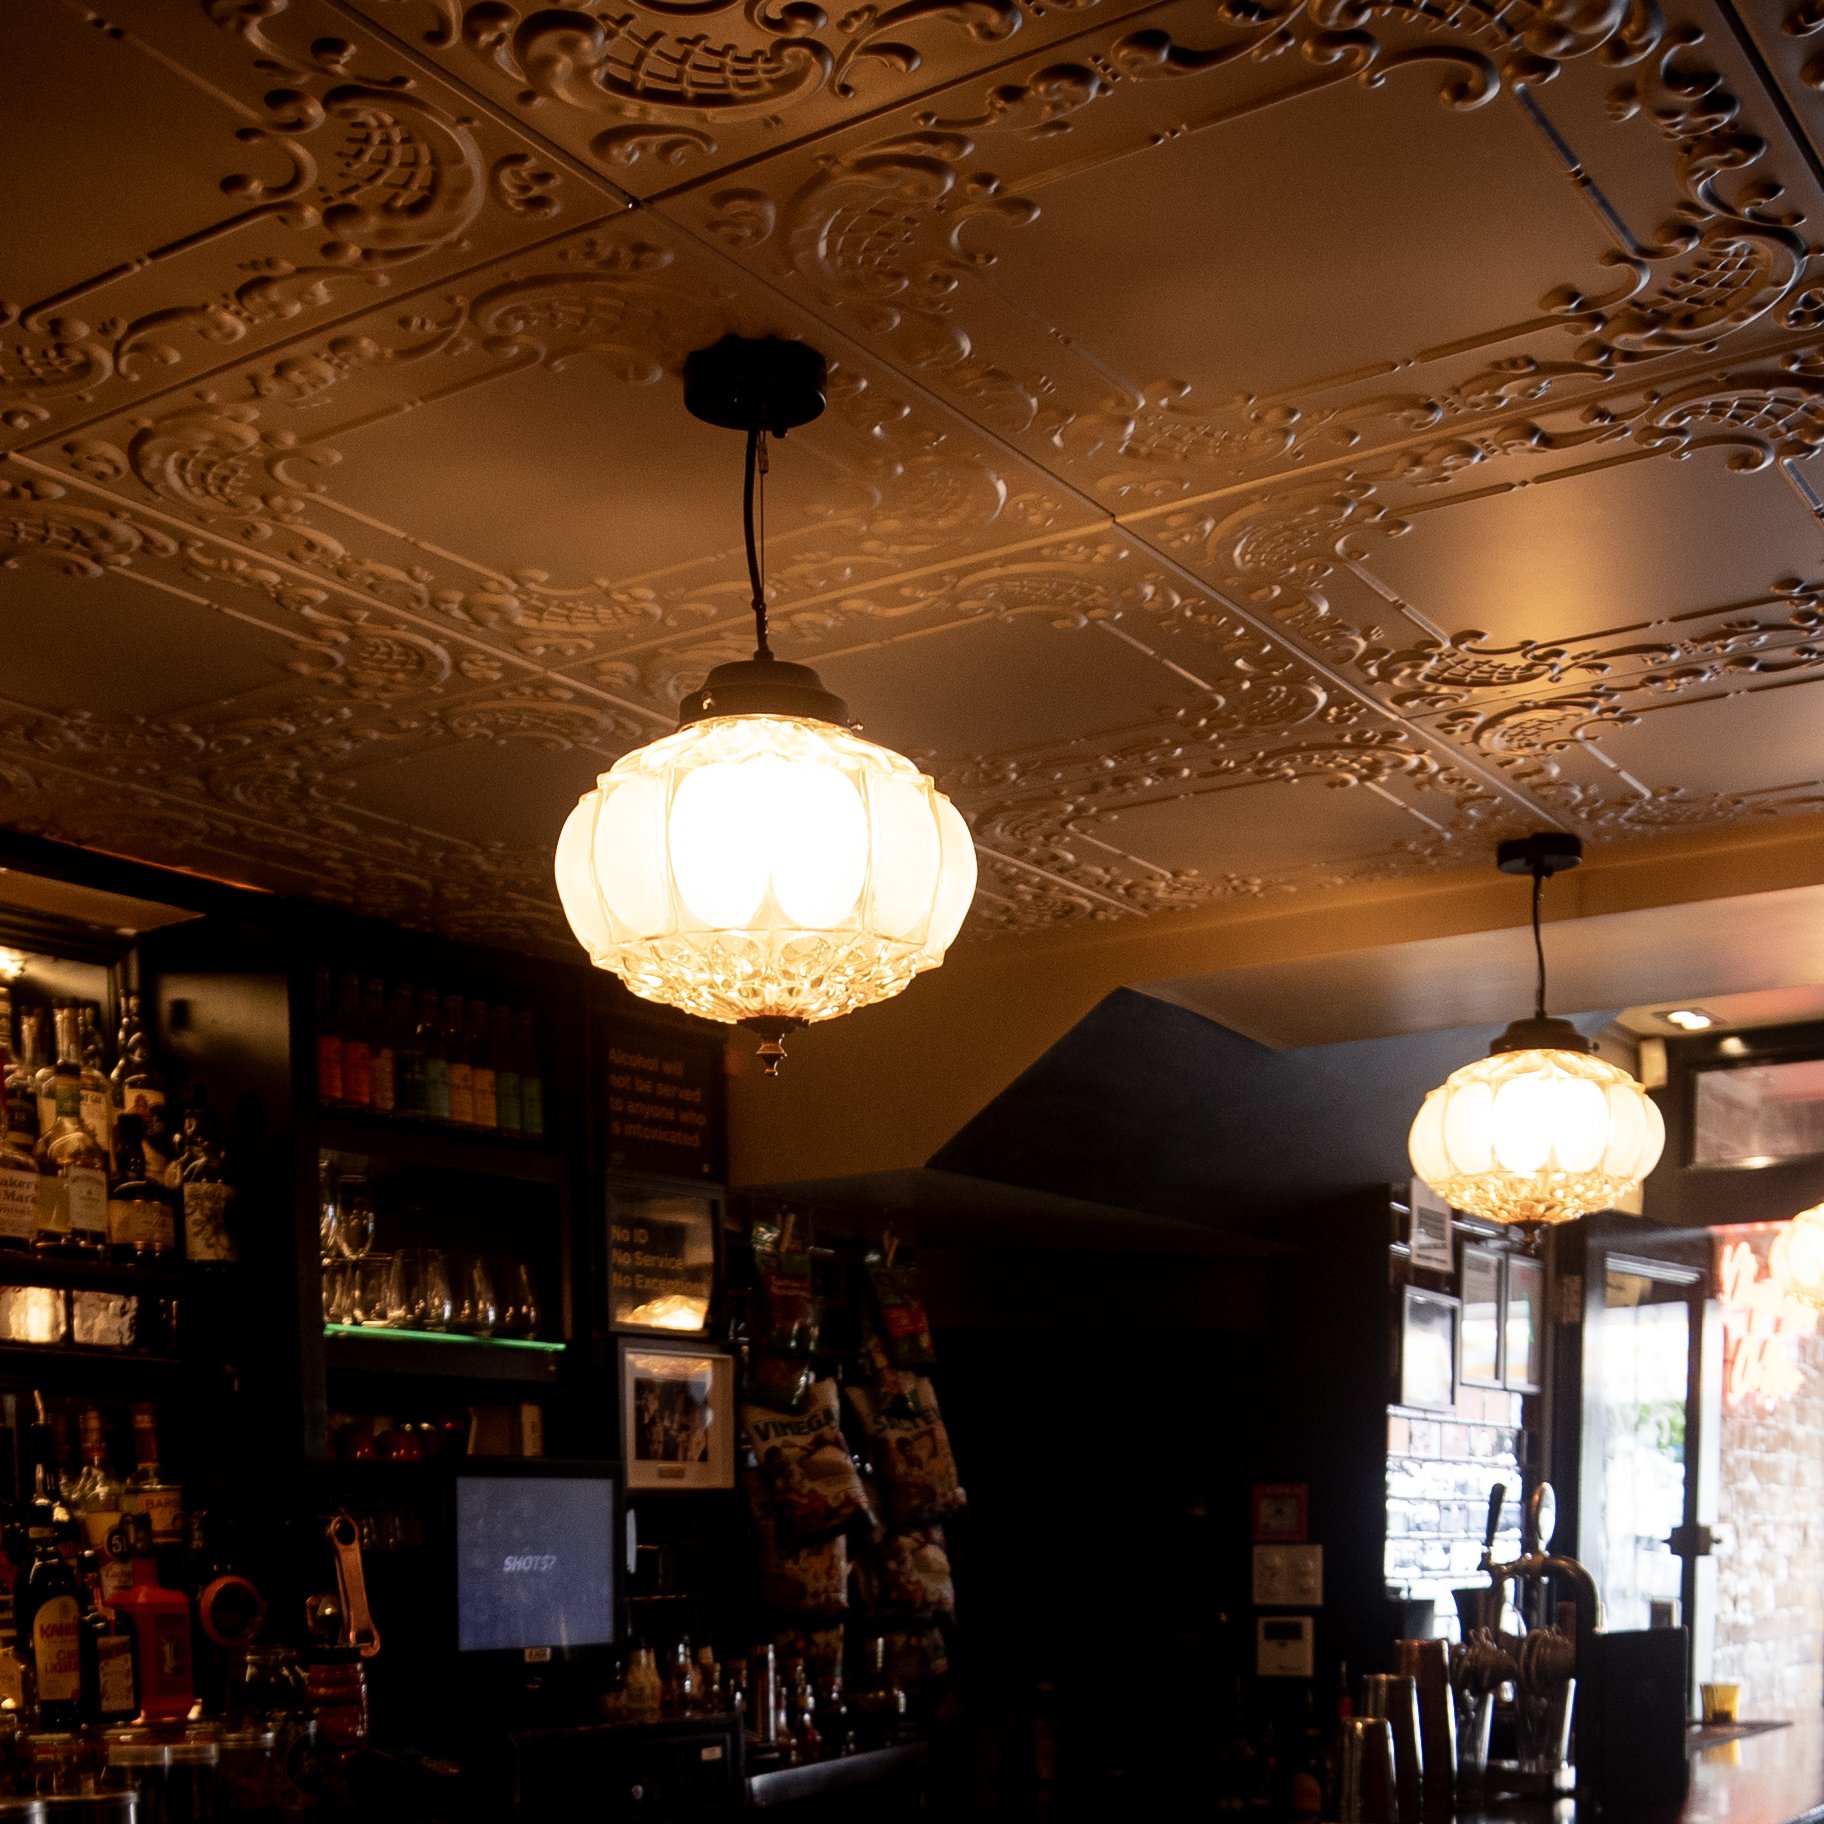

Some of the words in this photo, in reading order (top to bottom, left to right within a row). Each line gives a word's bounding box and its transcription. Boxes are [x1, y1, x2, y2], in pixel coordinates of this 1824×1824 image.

[610, 1224, 631, 1243] No
[611, 1247, 633, 1266] No
[634, 1250, 684, 1271] Service
[612, 1270, 633, 1289] No
[502, 1554, 557, 1572] SHOTS?
